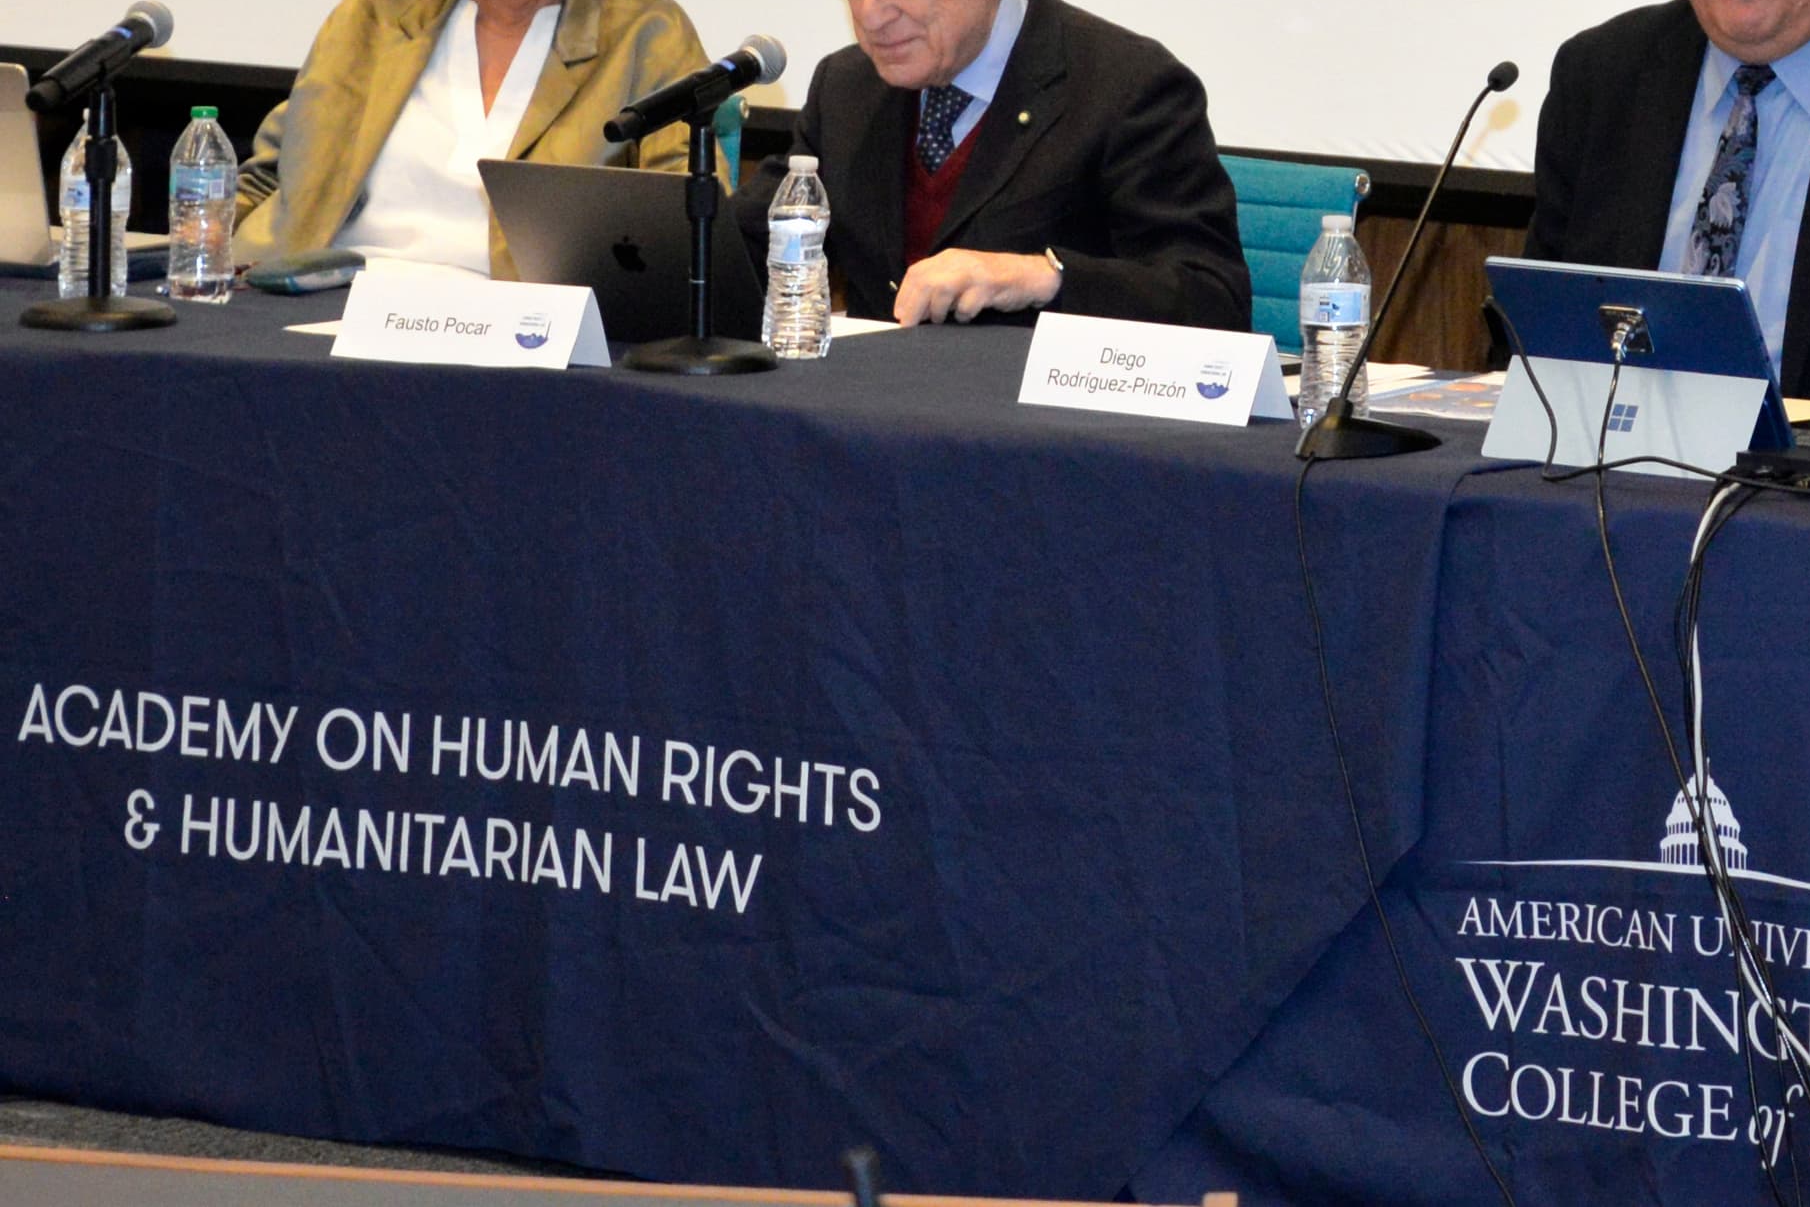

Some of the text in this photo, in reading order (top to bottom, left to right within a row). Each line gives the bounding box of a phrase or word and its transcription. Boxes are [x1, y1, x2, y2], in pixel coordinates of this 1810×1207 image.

[384, 312, 492, 336] Fausto Pocar
[1047, 367, 1187, 399] Rodríguez-Pinzón
[1099, 347, 1146, 371] Diego
[18, 683, 881, 832] ACADEMY ON HUMAN RIGHTS
[124, 789, 763, 914] & HUMANITARIAN LAW
[1457, 896, 1676, 953] AMERICAN
[1462, 1051, 1738, 1141] COLLEGE
[1748, 1084, 1805, 1170] of
